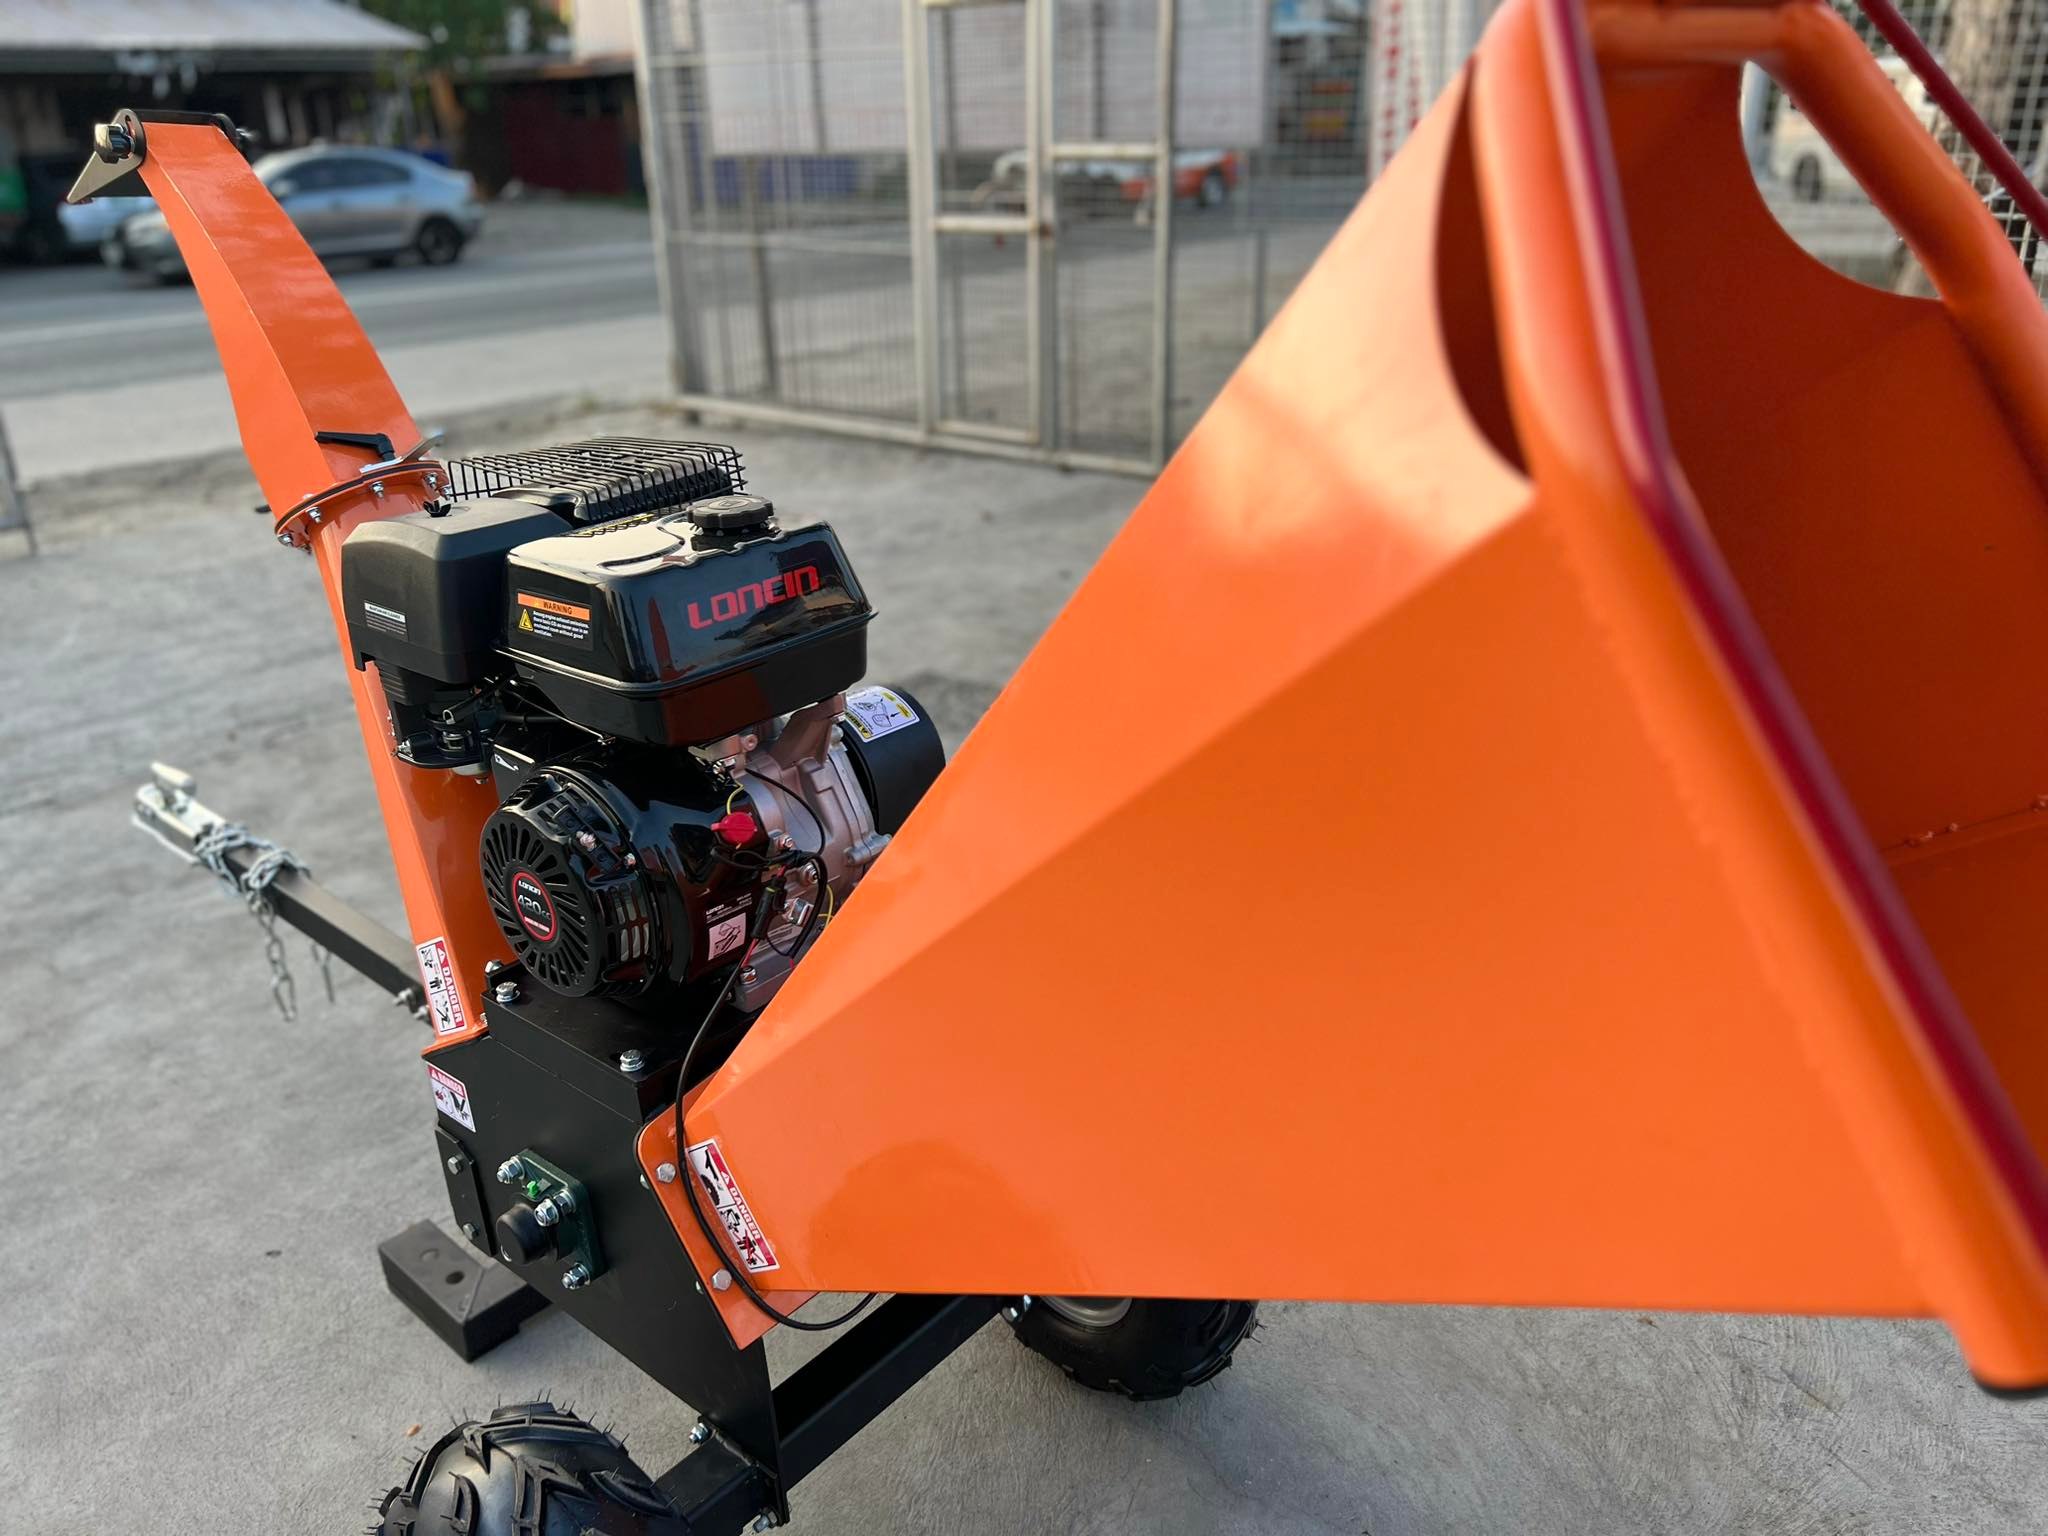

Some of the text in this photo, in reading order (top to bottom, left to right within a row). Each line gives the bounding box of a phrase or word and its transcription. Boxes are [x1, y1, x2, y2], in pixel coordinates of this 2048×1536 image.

[543, 601, 573, 615] WARNING
[442, 966, 463, 1023] DANGER
[729, 1186, 762, 1240] DANGER
